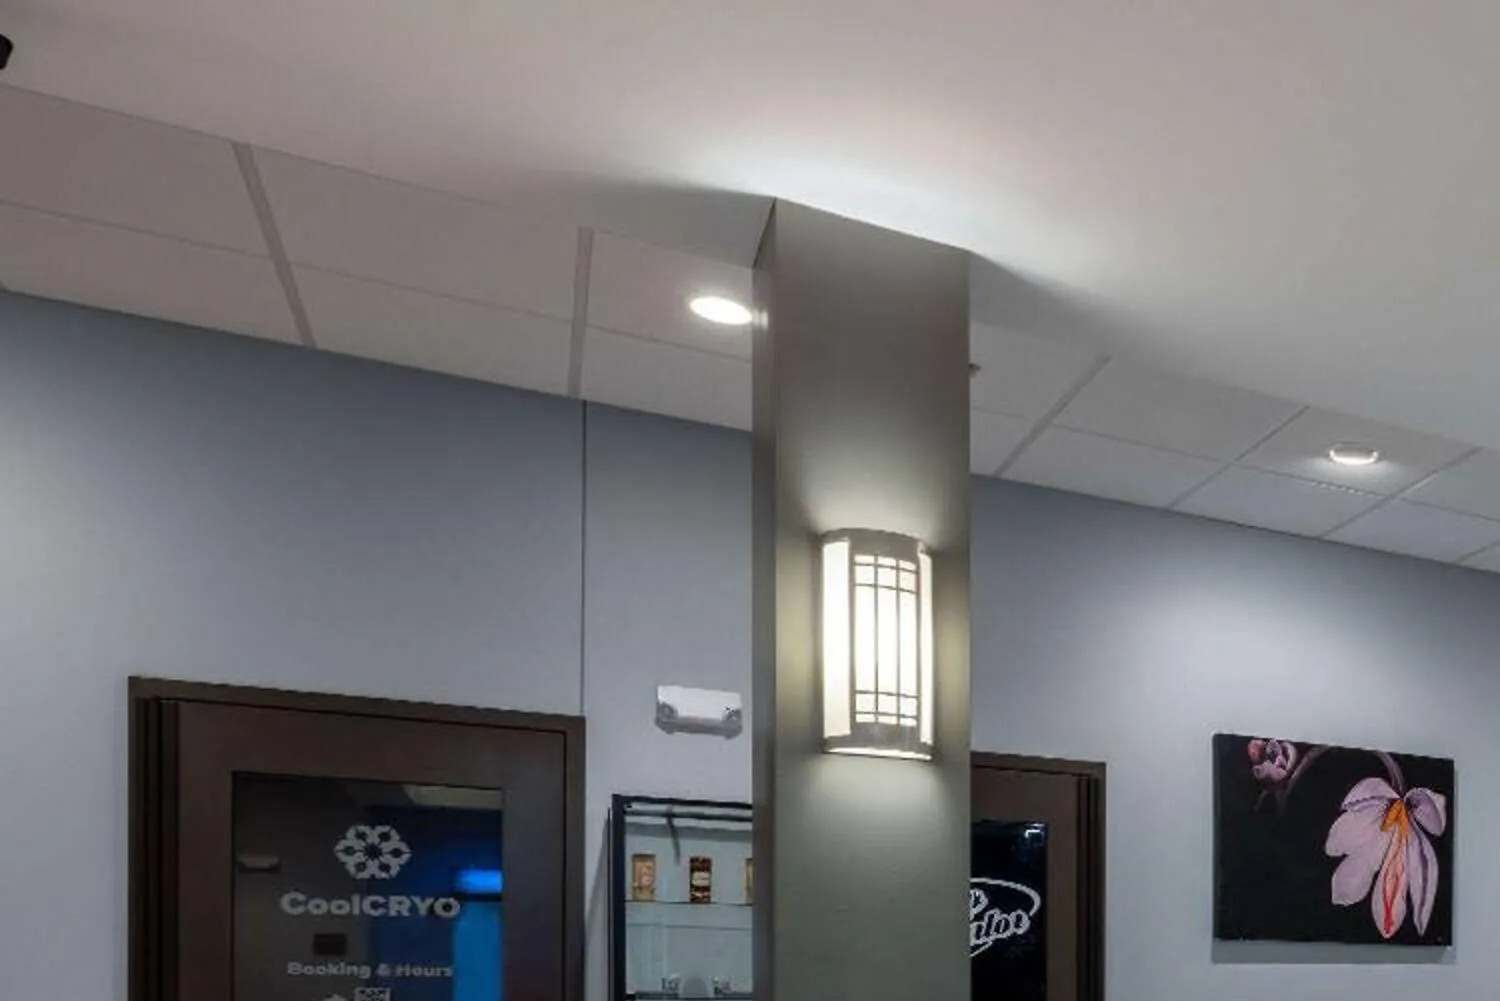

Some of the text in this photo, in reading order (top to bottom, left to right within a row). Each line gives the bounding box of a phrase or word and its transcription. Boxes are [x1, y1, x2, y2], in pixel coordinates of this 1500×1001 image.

[280, 891, 461, 917] CoolCRYO
[287, 962, 453, 979] Booking & Hours
